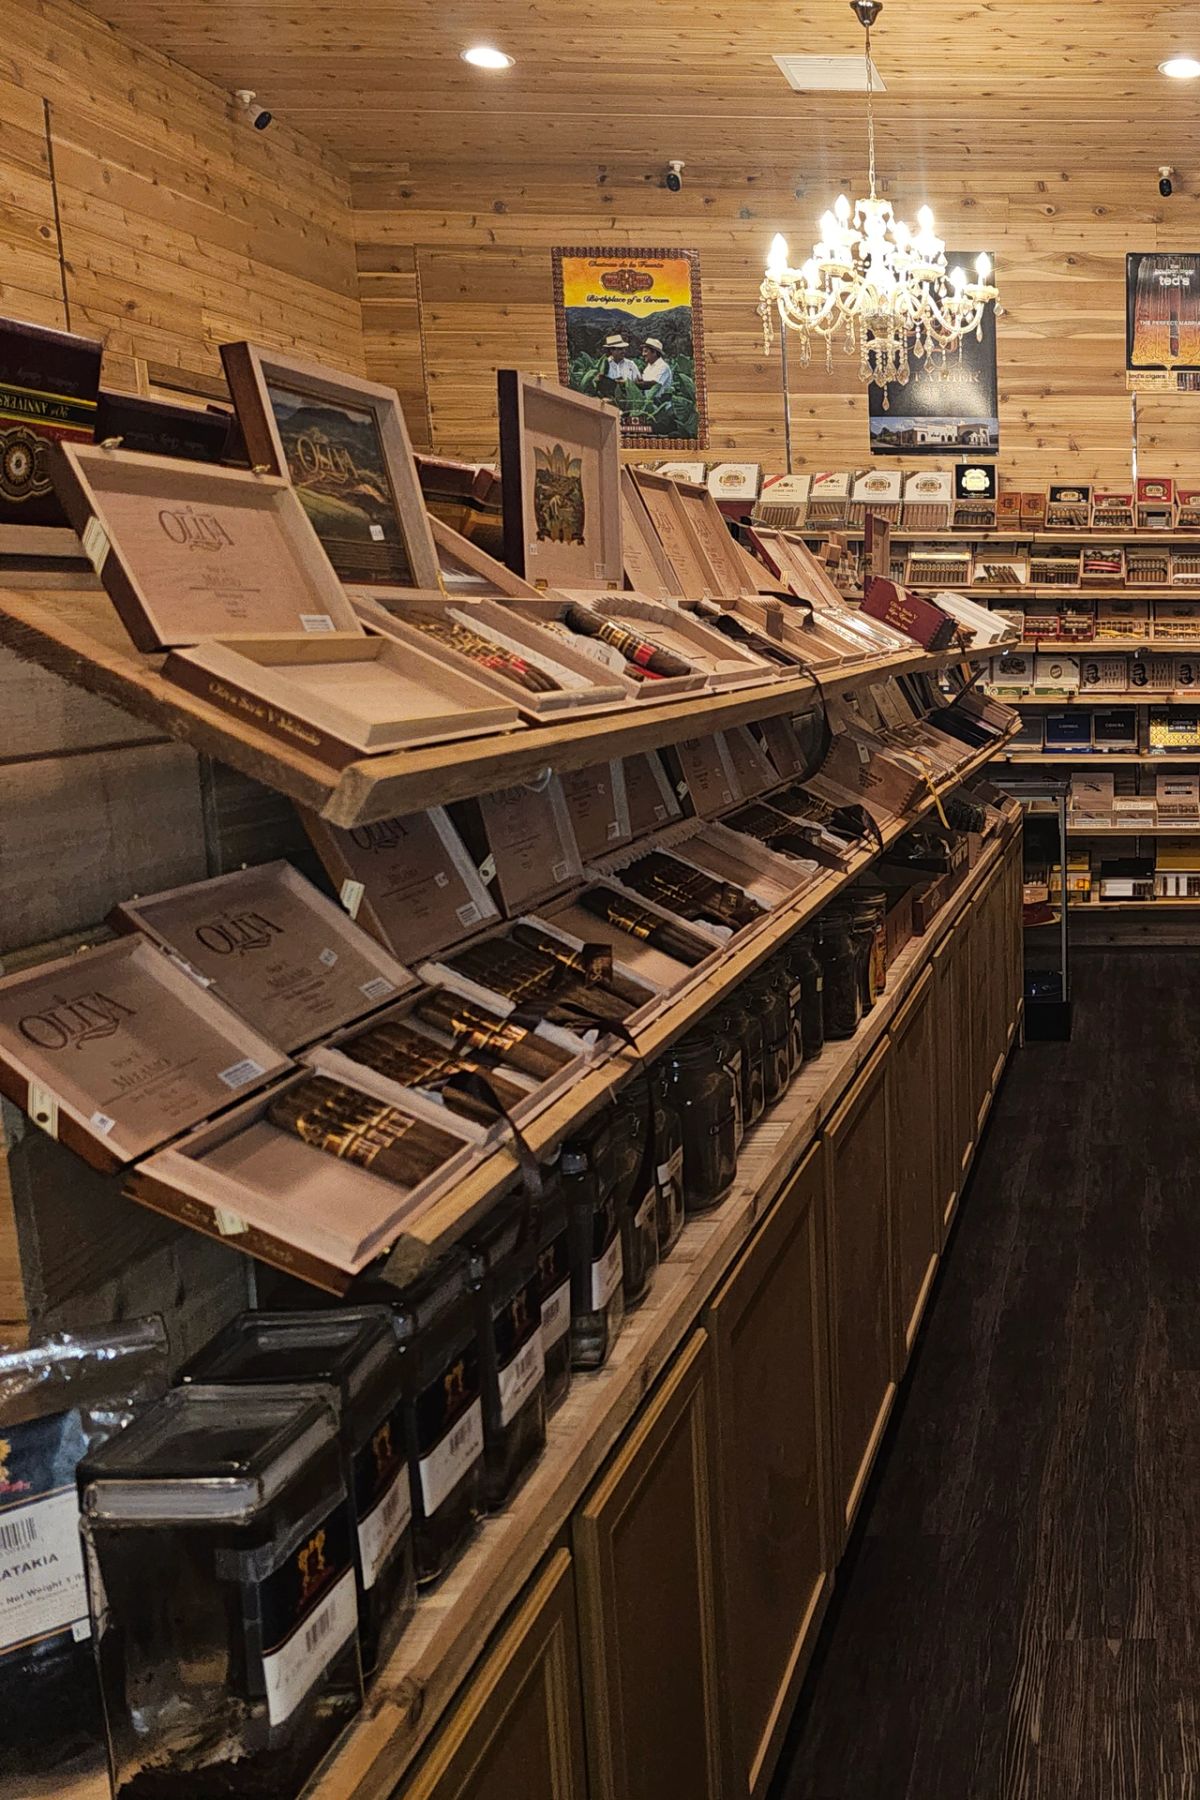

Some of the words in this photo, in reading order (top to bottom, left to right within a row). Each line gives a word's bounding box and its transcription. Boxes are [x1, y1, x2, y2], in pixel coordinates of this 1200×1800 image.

[1159, 276, 1190, 286] ted's
[587, 295, 627, 304] Birthplace
[643, 295, 670, 303] Dream
[158, 508, 235, 547] OLIVA
[195, 913, 284, 954] OLIVA
[18, 992, 137, 1050] OLIVA
[0, 1552, 59, 1581] ATAKIA
[6, 1594, 25, 1604] Net
[26, 1579, 63, 1598] Weight
